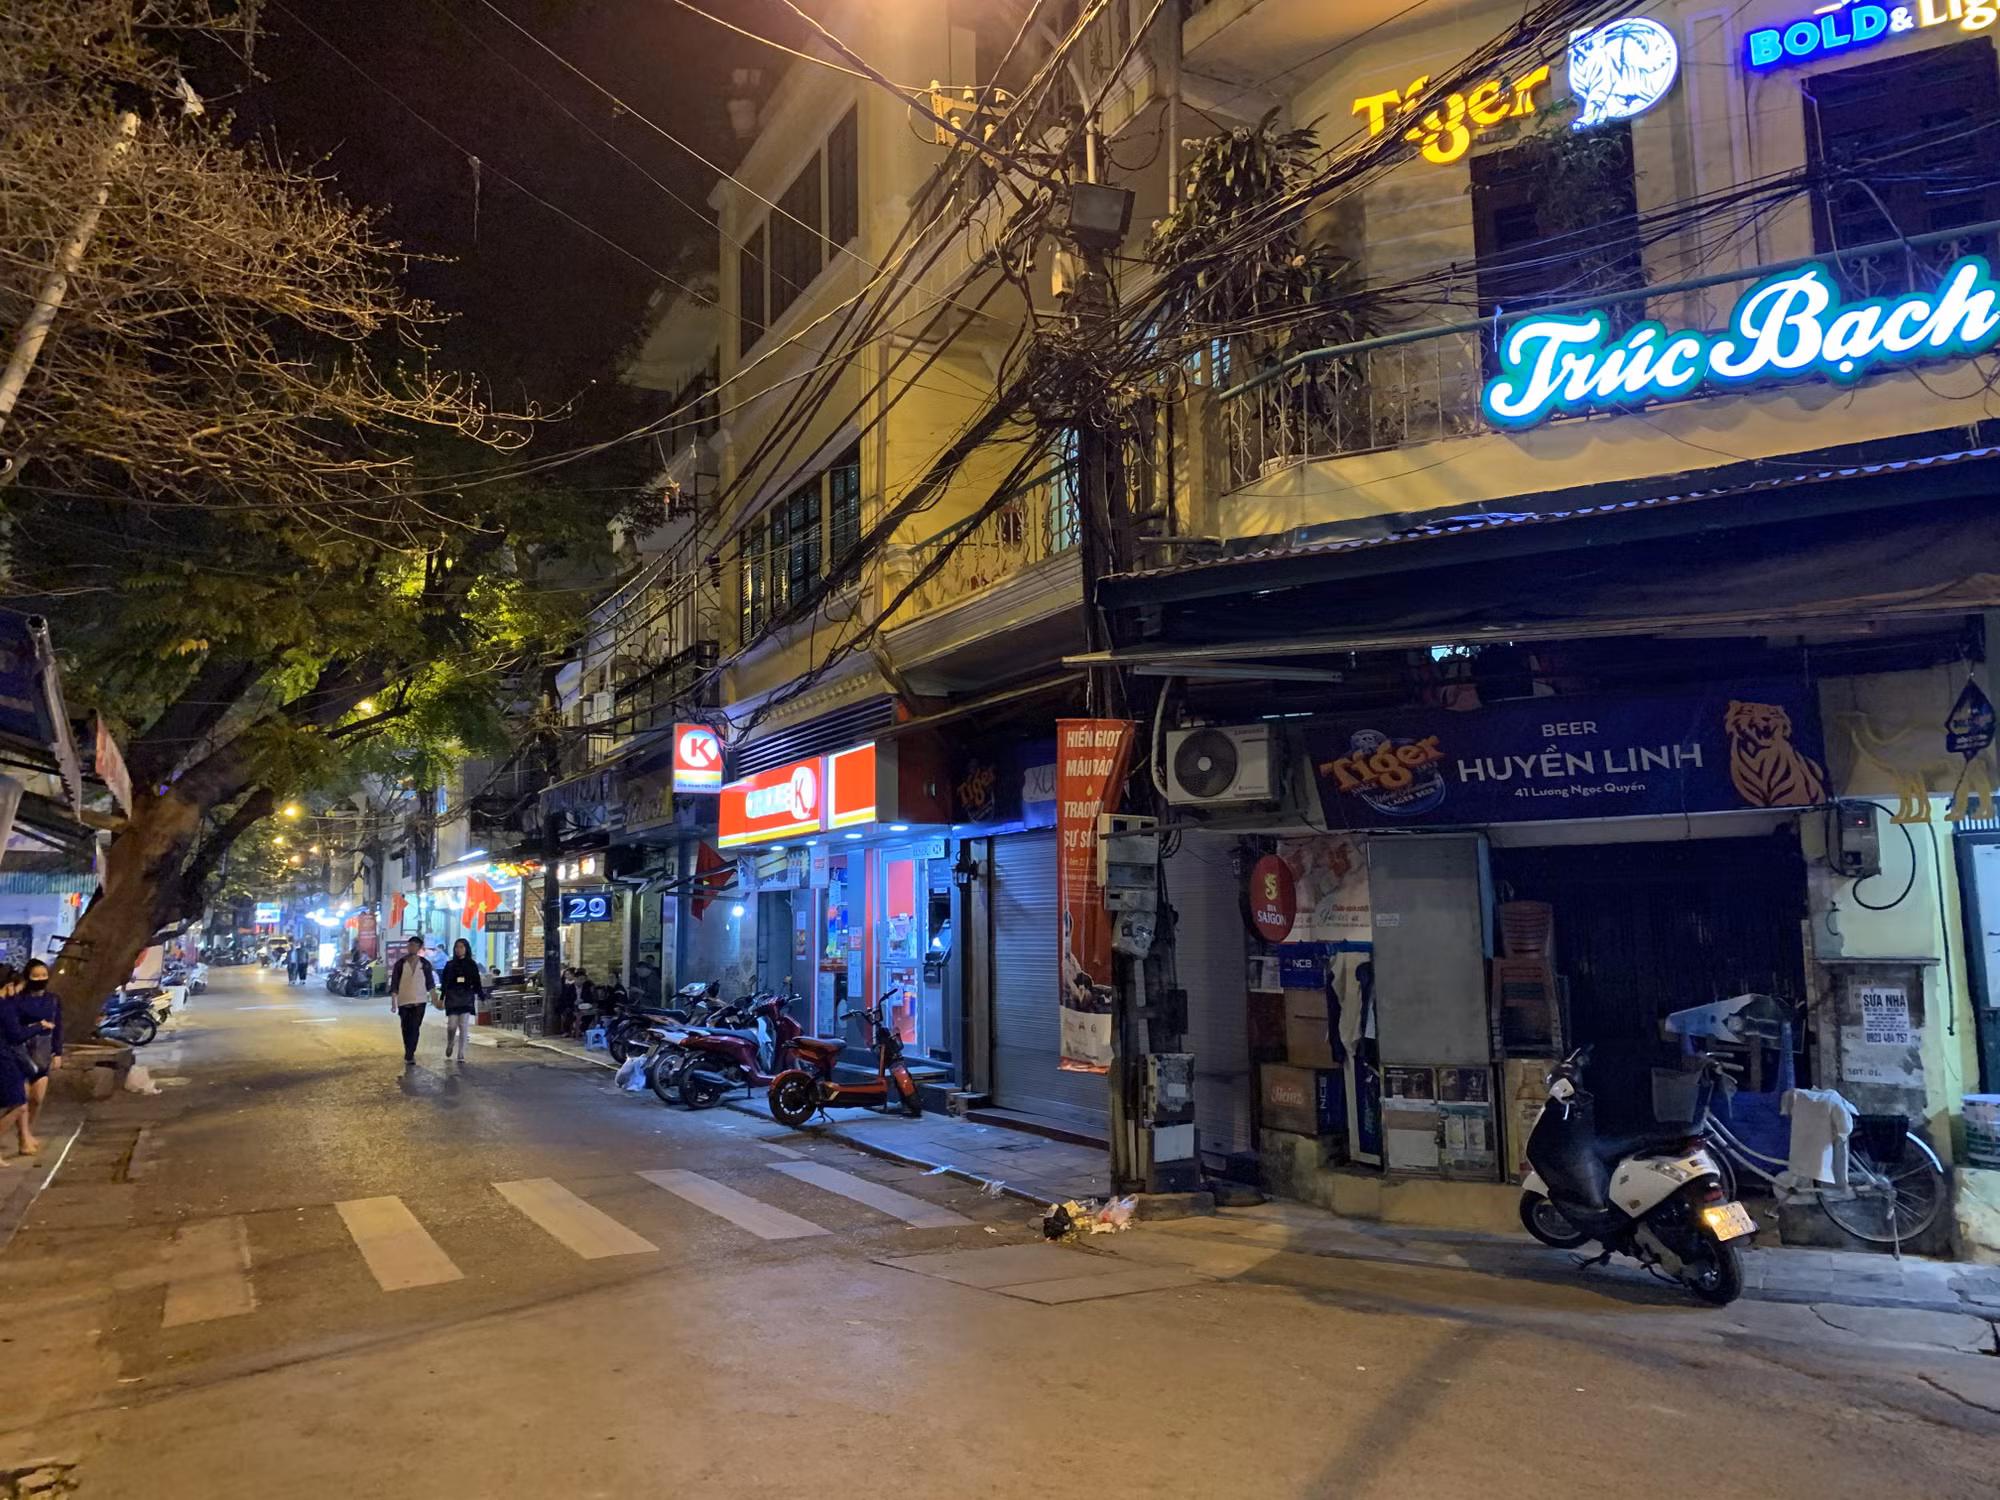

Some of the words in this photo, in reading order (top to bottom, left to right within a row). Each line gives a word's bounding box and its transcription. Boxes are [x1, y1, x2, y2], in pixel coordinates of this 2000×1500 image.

[1750, 5, 1888, 66] BOLD
[1890, 6, 1914, 32] &
[1489, 316, 1702, 418] Trúc
[1708, 263, 2000, 377] Bạch
[1066, 725, 1093, 748] HIẾN
[1094, 730, 1122, 751] GIỌT
[1541, 721, 1599, 737] BEER
[1066, 756, 1092, 777] MÁU
[1319, 735, 1446, 792] Tiger
[1457, 744, 1595, 782] HUYỀN
[1603, 743, 1703, 774] LINH
[1514, 788, 1529, 797] 41
[569, 897, 607, 918] 29
[1257, 910, 1287, 926] SAIGON
[1292, 959, 1312, 968] NCB
